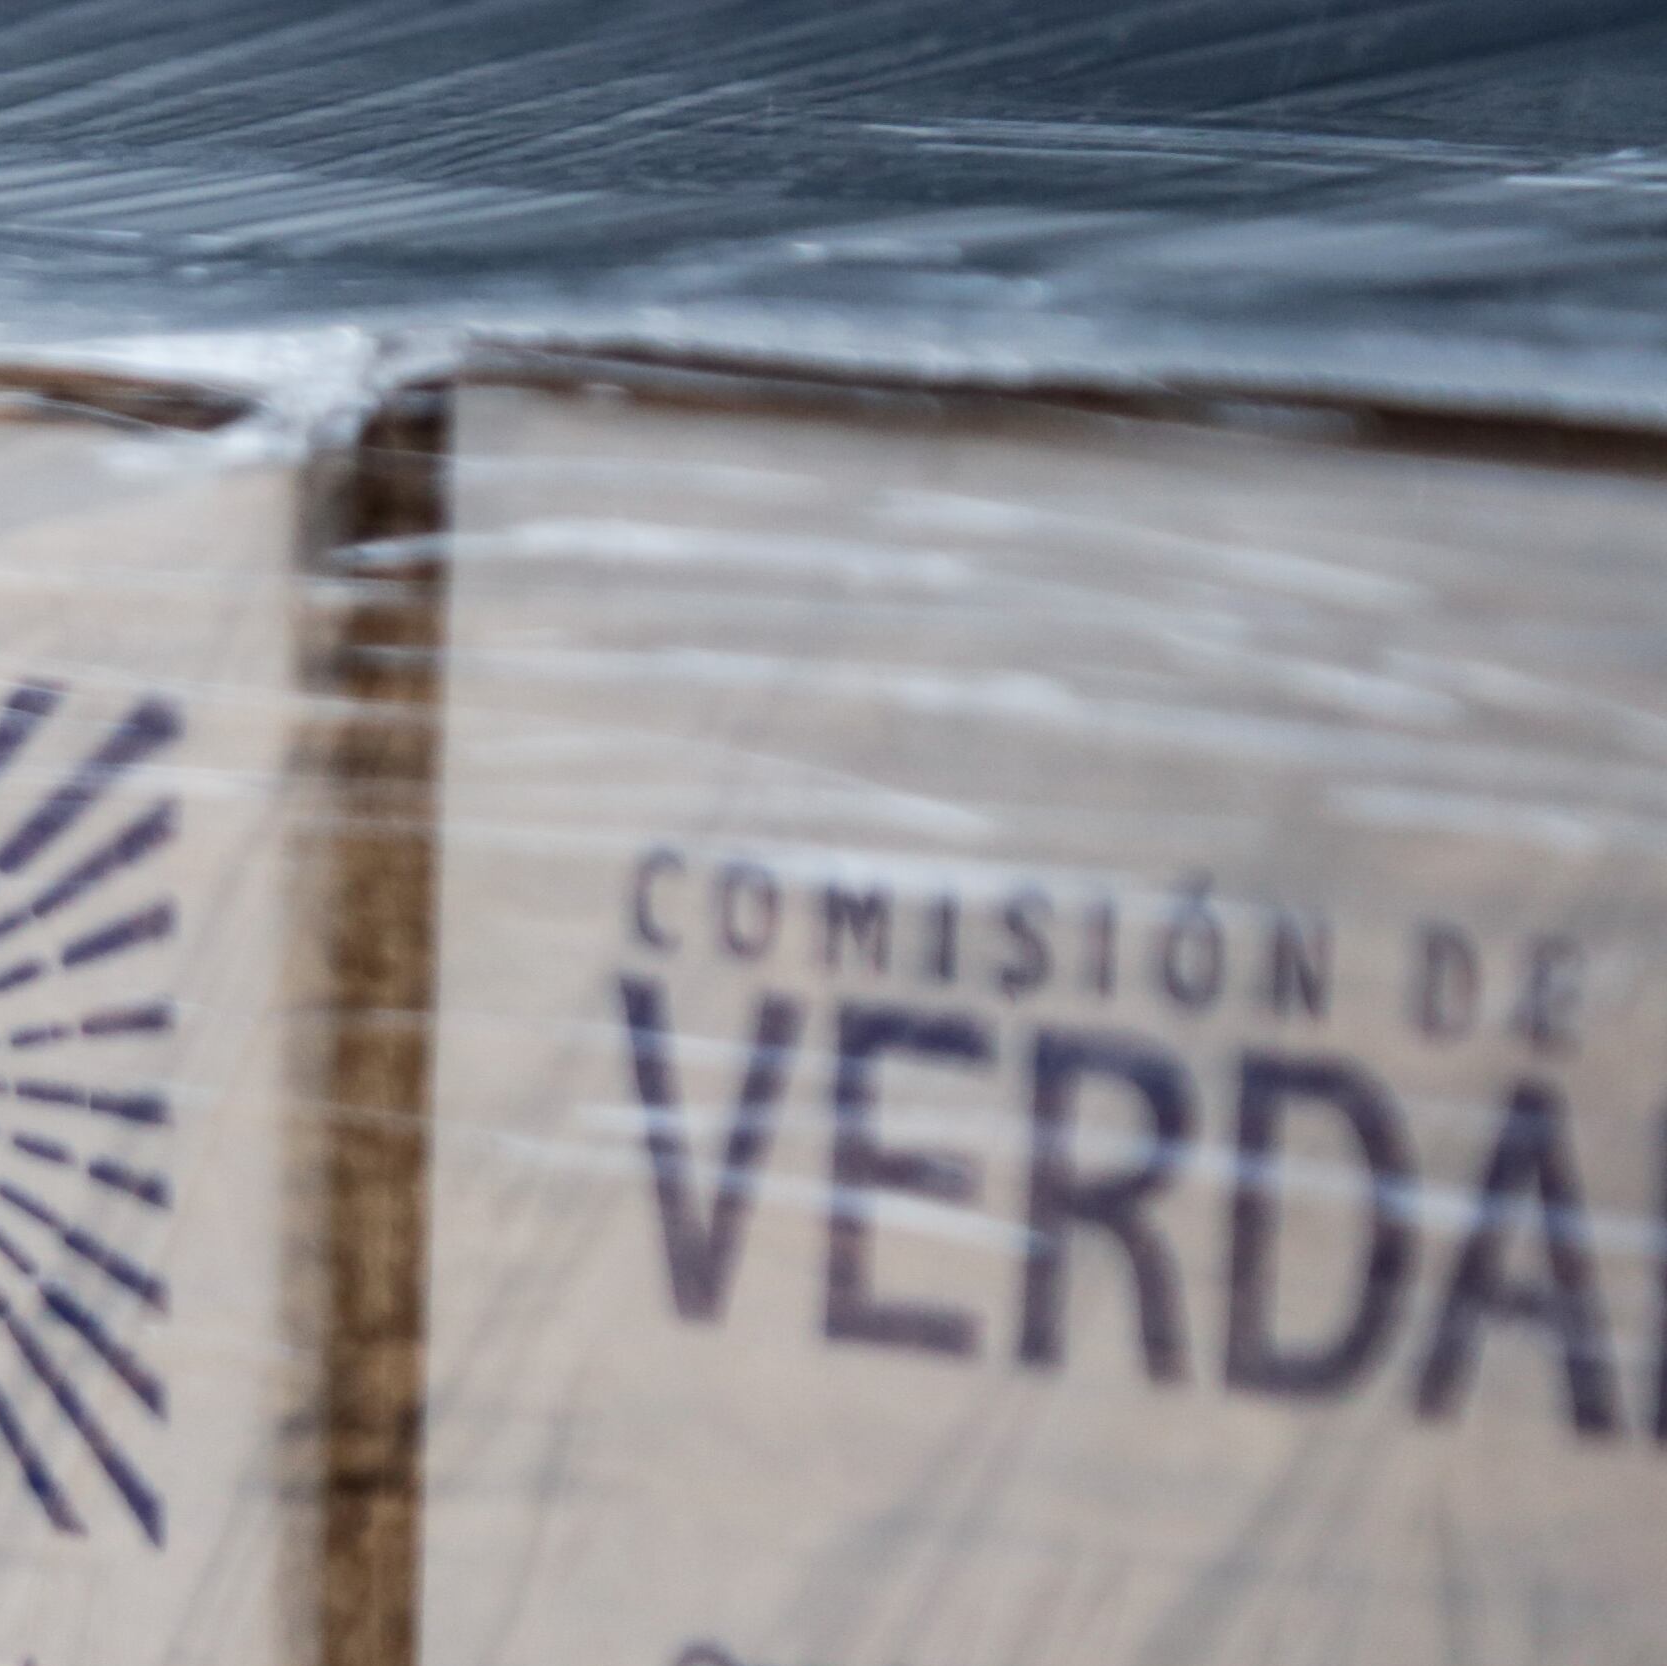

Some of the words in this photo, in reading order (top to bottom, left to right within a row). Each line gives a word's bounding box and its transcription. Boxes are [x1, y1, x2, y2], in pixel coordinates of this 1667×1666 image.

[629, 850, 1335, 1022] COMISIÓN
[1414, 920, 1587, 1048] DE
[615, 972, 1667, 1445] VERDA
